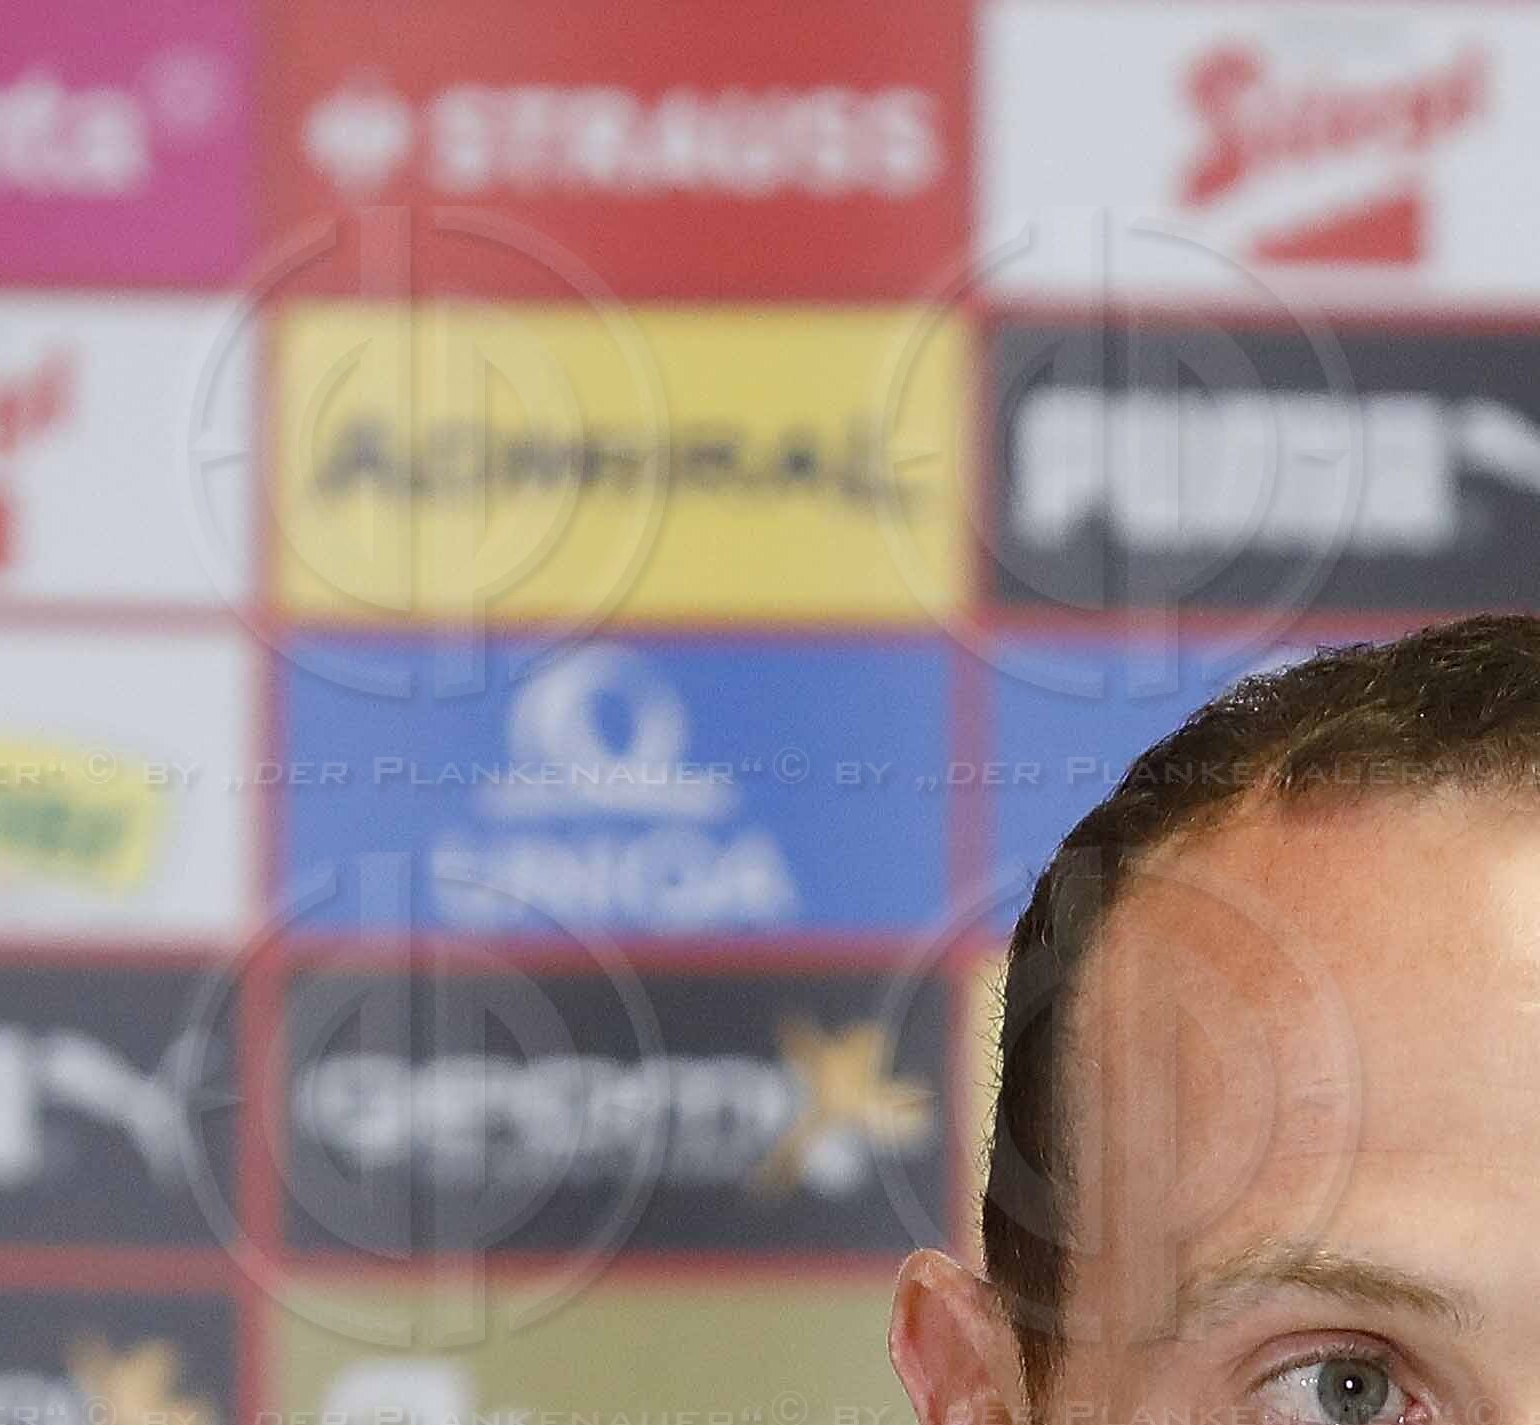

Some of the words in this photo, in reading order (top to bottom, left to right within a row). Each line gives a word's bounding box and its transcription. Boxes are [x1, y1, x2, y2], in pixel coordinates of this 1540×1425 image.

[430, 84, 945, 197] STRAUSS
[313, 403, 926, 513] ADMIRAL
[1010, 383, 1452, 562] PUMA
